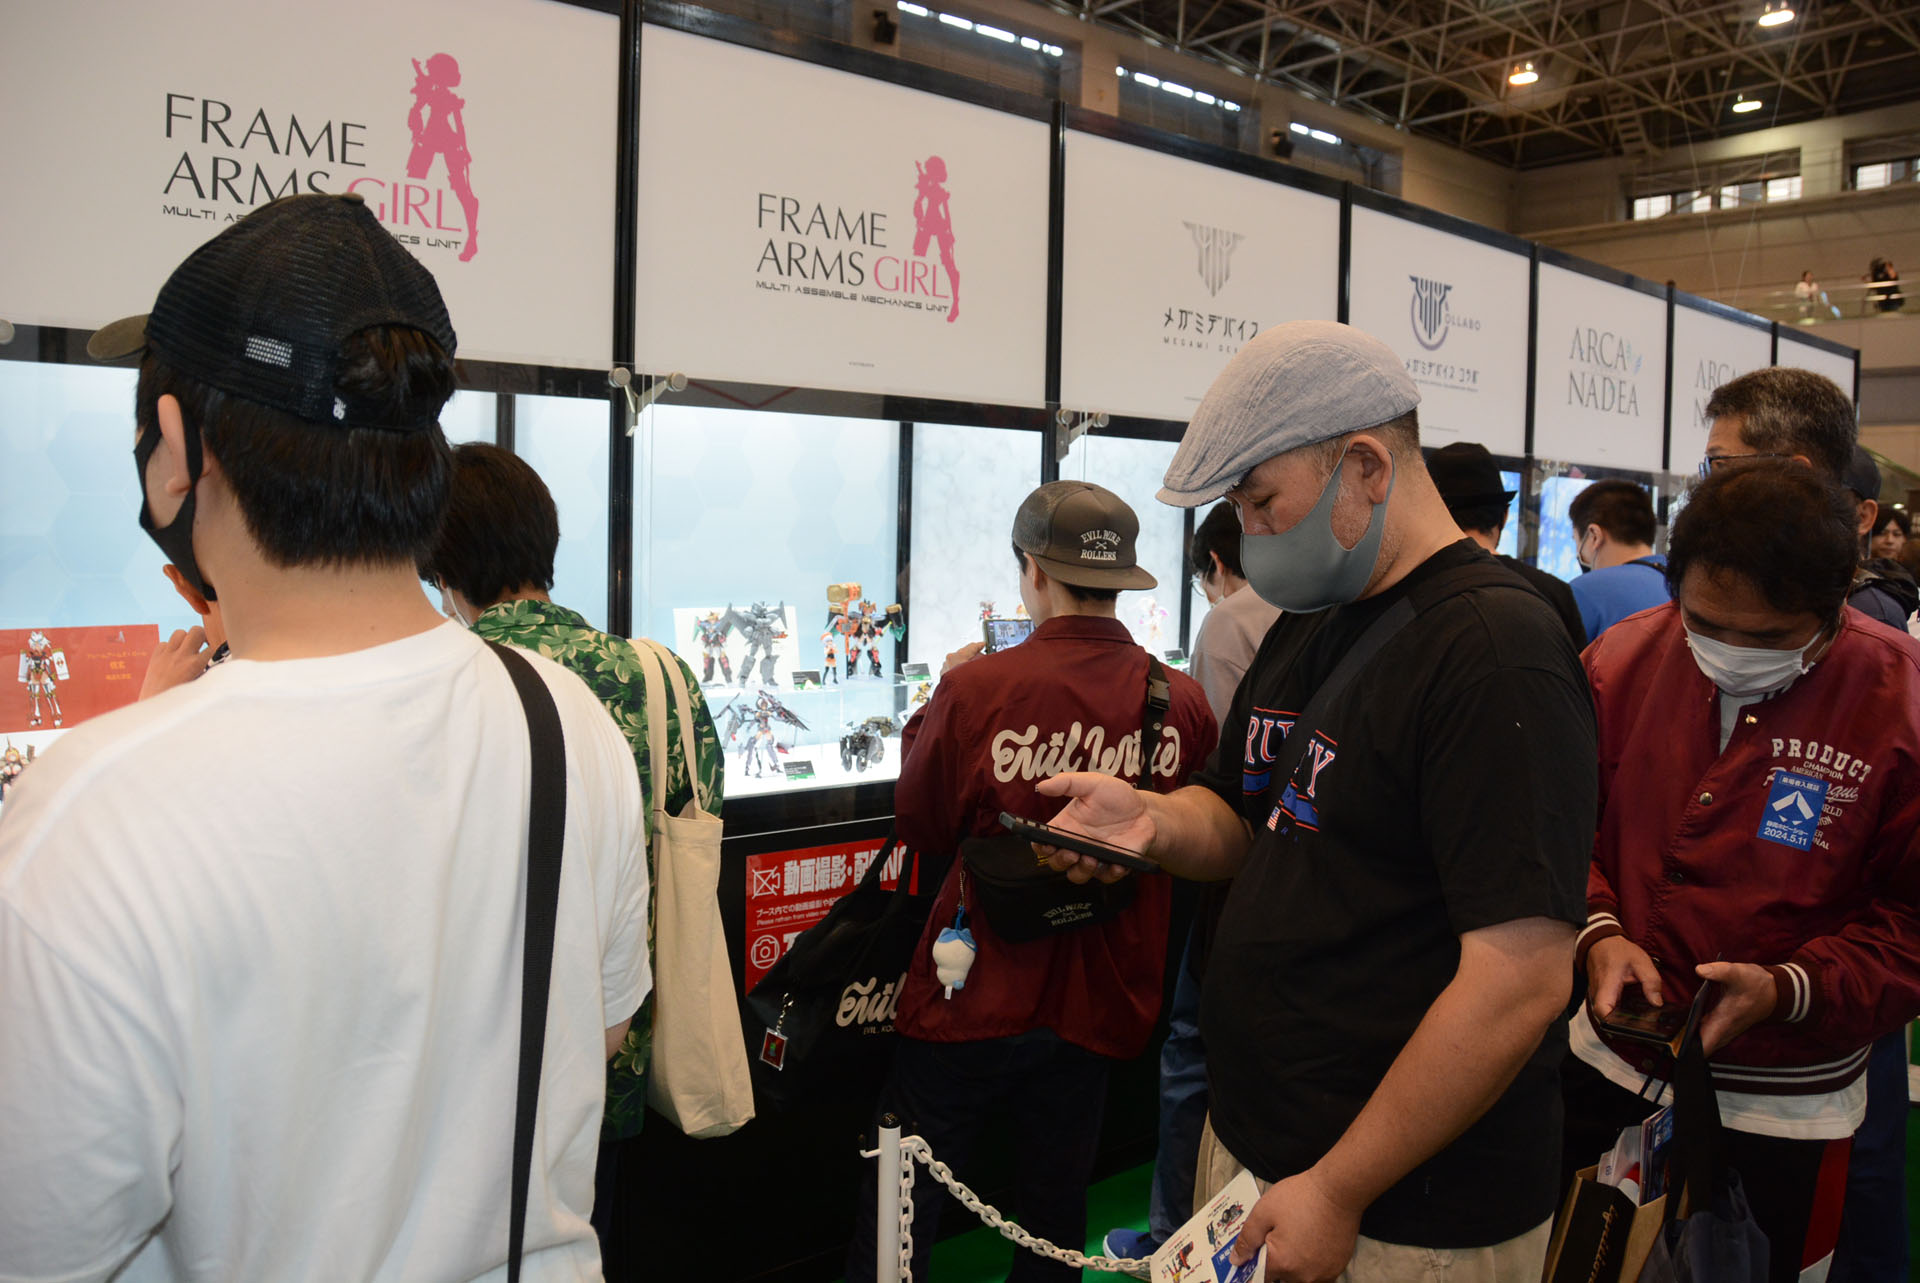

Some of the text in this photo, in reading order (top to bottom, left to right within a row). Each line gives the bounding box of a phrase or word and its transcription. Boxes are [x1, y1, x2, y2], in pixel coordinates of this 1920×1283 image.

[165, 92, 367, 168] FRAME
[162, 151, 462, 232] ARMS GIRL
[162, 204, 216, 221] MULTI
[426, 236, 462, 250] UNIT
[757, 192, 888, 248] FRAME
[756, 238, 950, 300] ARMS GIRL
[755, 279, 950, 313] MULTI ASSEMBLE MECHANICS UNIT
[1163, 336, 1209, 350] MEGAMI
[1569, 327, 1627, 371] ARCA
[1567, 371, 1639, 417] NADEA
[1080, 530, 1102, 544] EVIL
[1080, 549, 1117, 561] ROLLERS
[1084, 725, 1181, 778] Wie
[1771, 738, 1873, 783] PRODUCT
[1791, 765, 1824, 780] AMERICAN
[1803, 761, 1844, 780] CHAMPION
[1822, 803, 1843, 817] RLD
[1763, 827, 1808, 846] 2024.5.11
